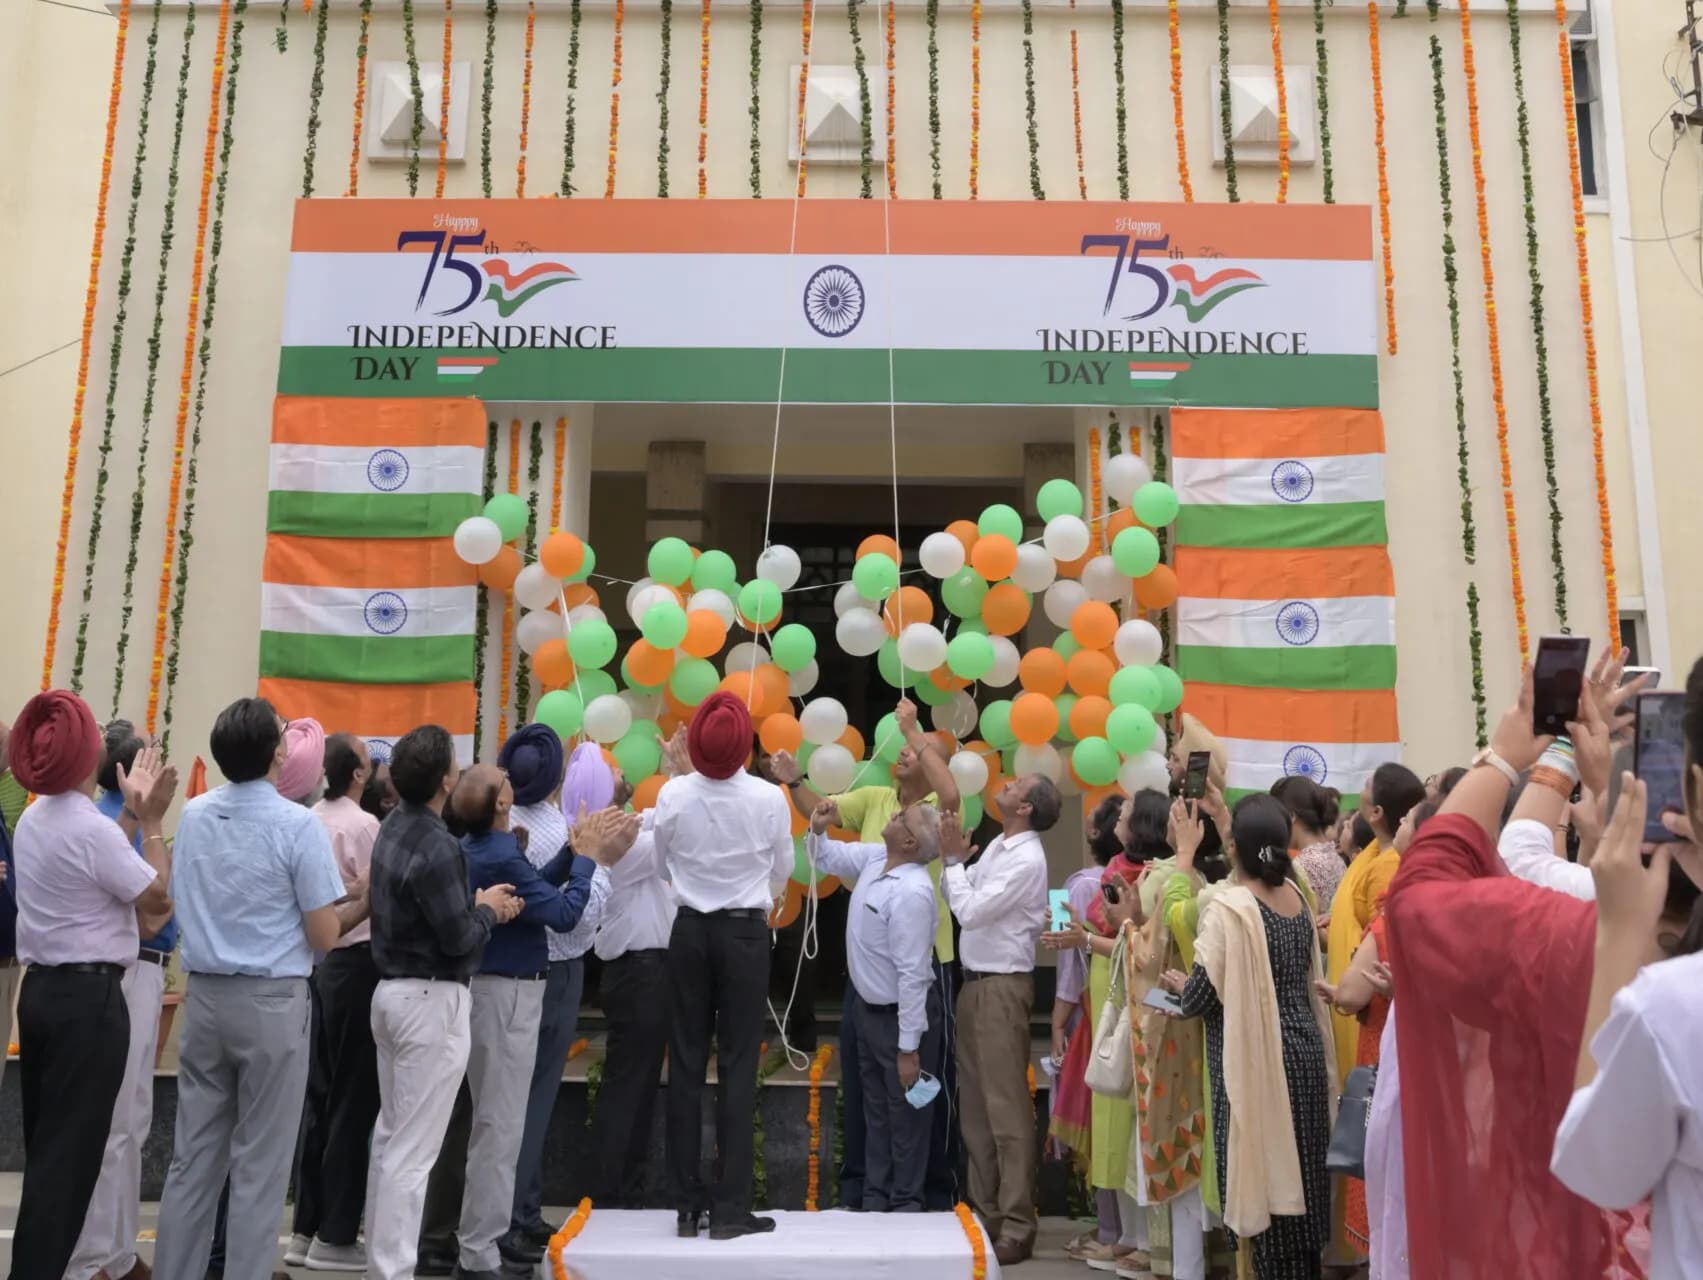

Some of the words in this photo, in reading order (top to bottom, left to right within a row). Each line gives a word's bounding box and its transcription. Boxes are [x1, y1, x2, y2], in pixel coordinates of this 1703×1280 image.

[347, 321, 617, 353] INDEPENDENCE
[1036, 326, 1309, 359] INDEPENDENCE
[351, 356, 420, 381] DAY
[1040, 360, 1111, 386] DAY
